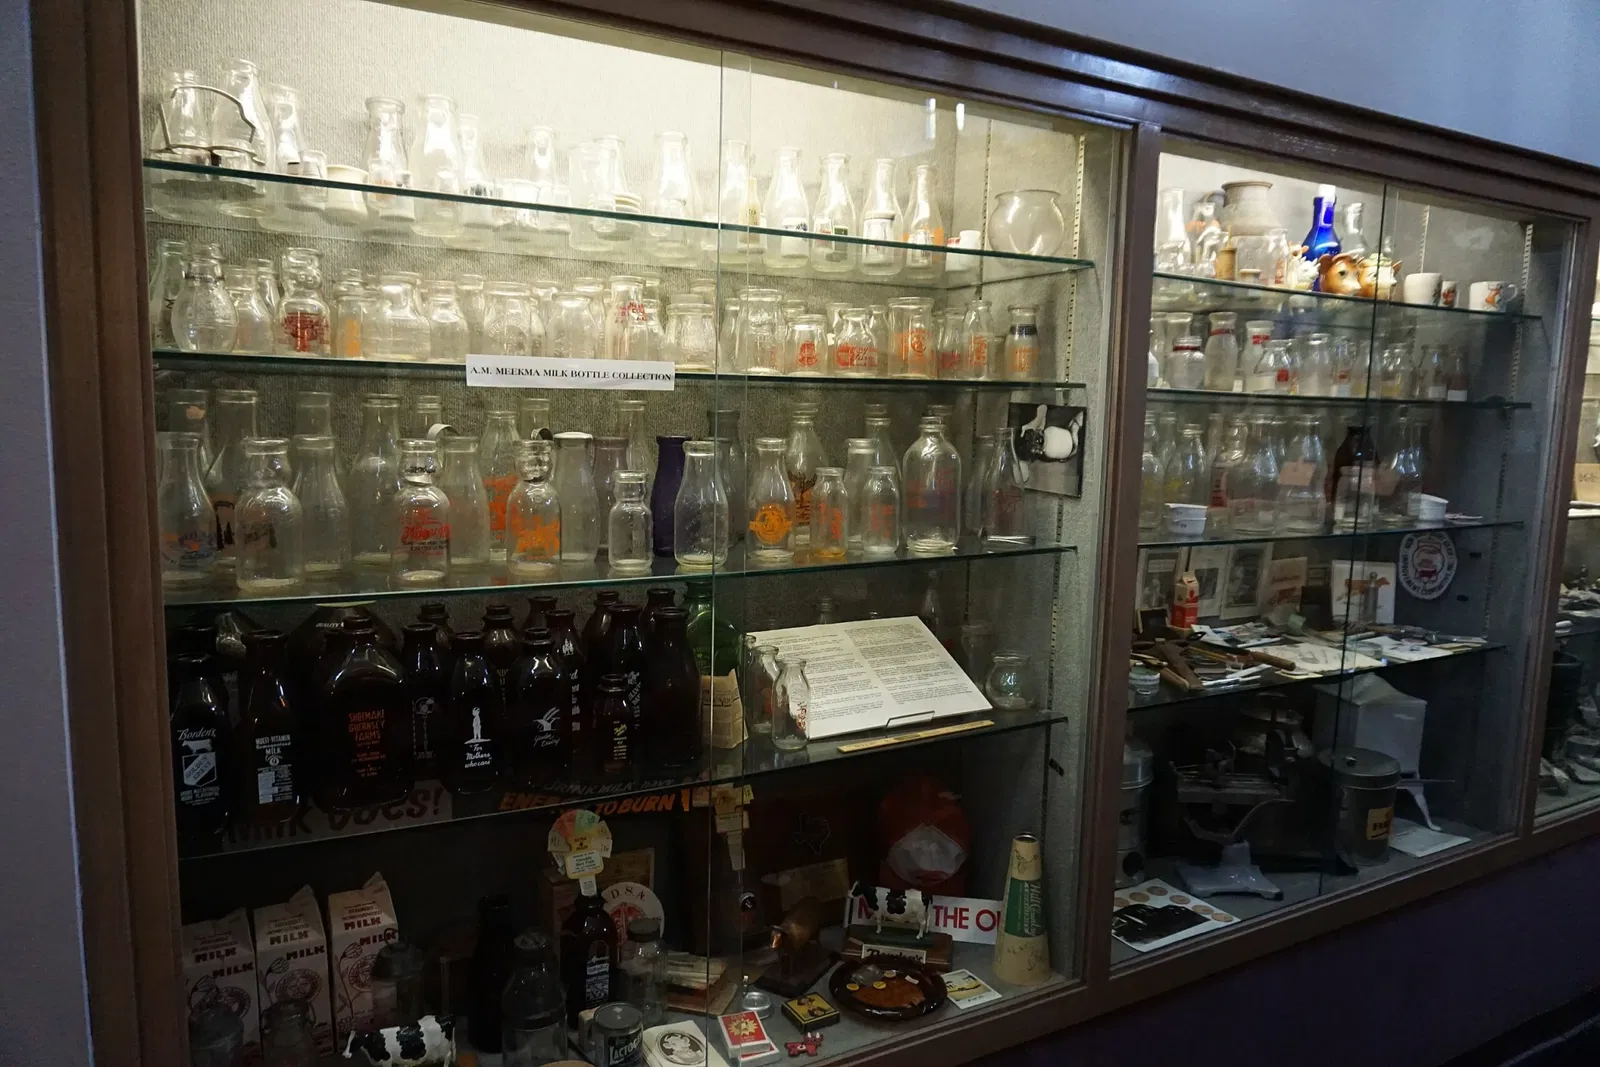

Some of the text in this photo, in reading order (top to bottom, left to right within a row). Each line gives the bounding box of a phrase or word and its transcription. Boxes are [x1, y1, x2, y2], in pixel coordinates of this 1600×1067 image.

[470, 367, 672, 381] A.M. MEEKMA MILK BOTTLE COLLECTION
[177, 724, 217, 741] Borden's
[594, 800, 614, 816] TO
[344, 917, 382, 931] MILK
[932, 904, 969, 930] THE
[270, 930, 309, 946] MILK
[359, 931, 396, 946] MILK
[195, 947, 237, 964] MILK
[286, 945, 325, 961] MILK
[212, 962, 255, 979] MILK
